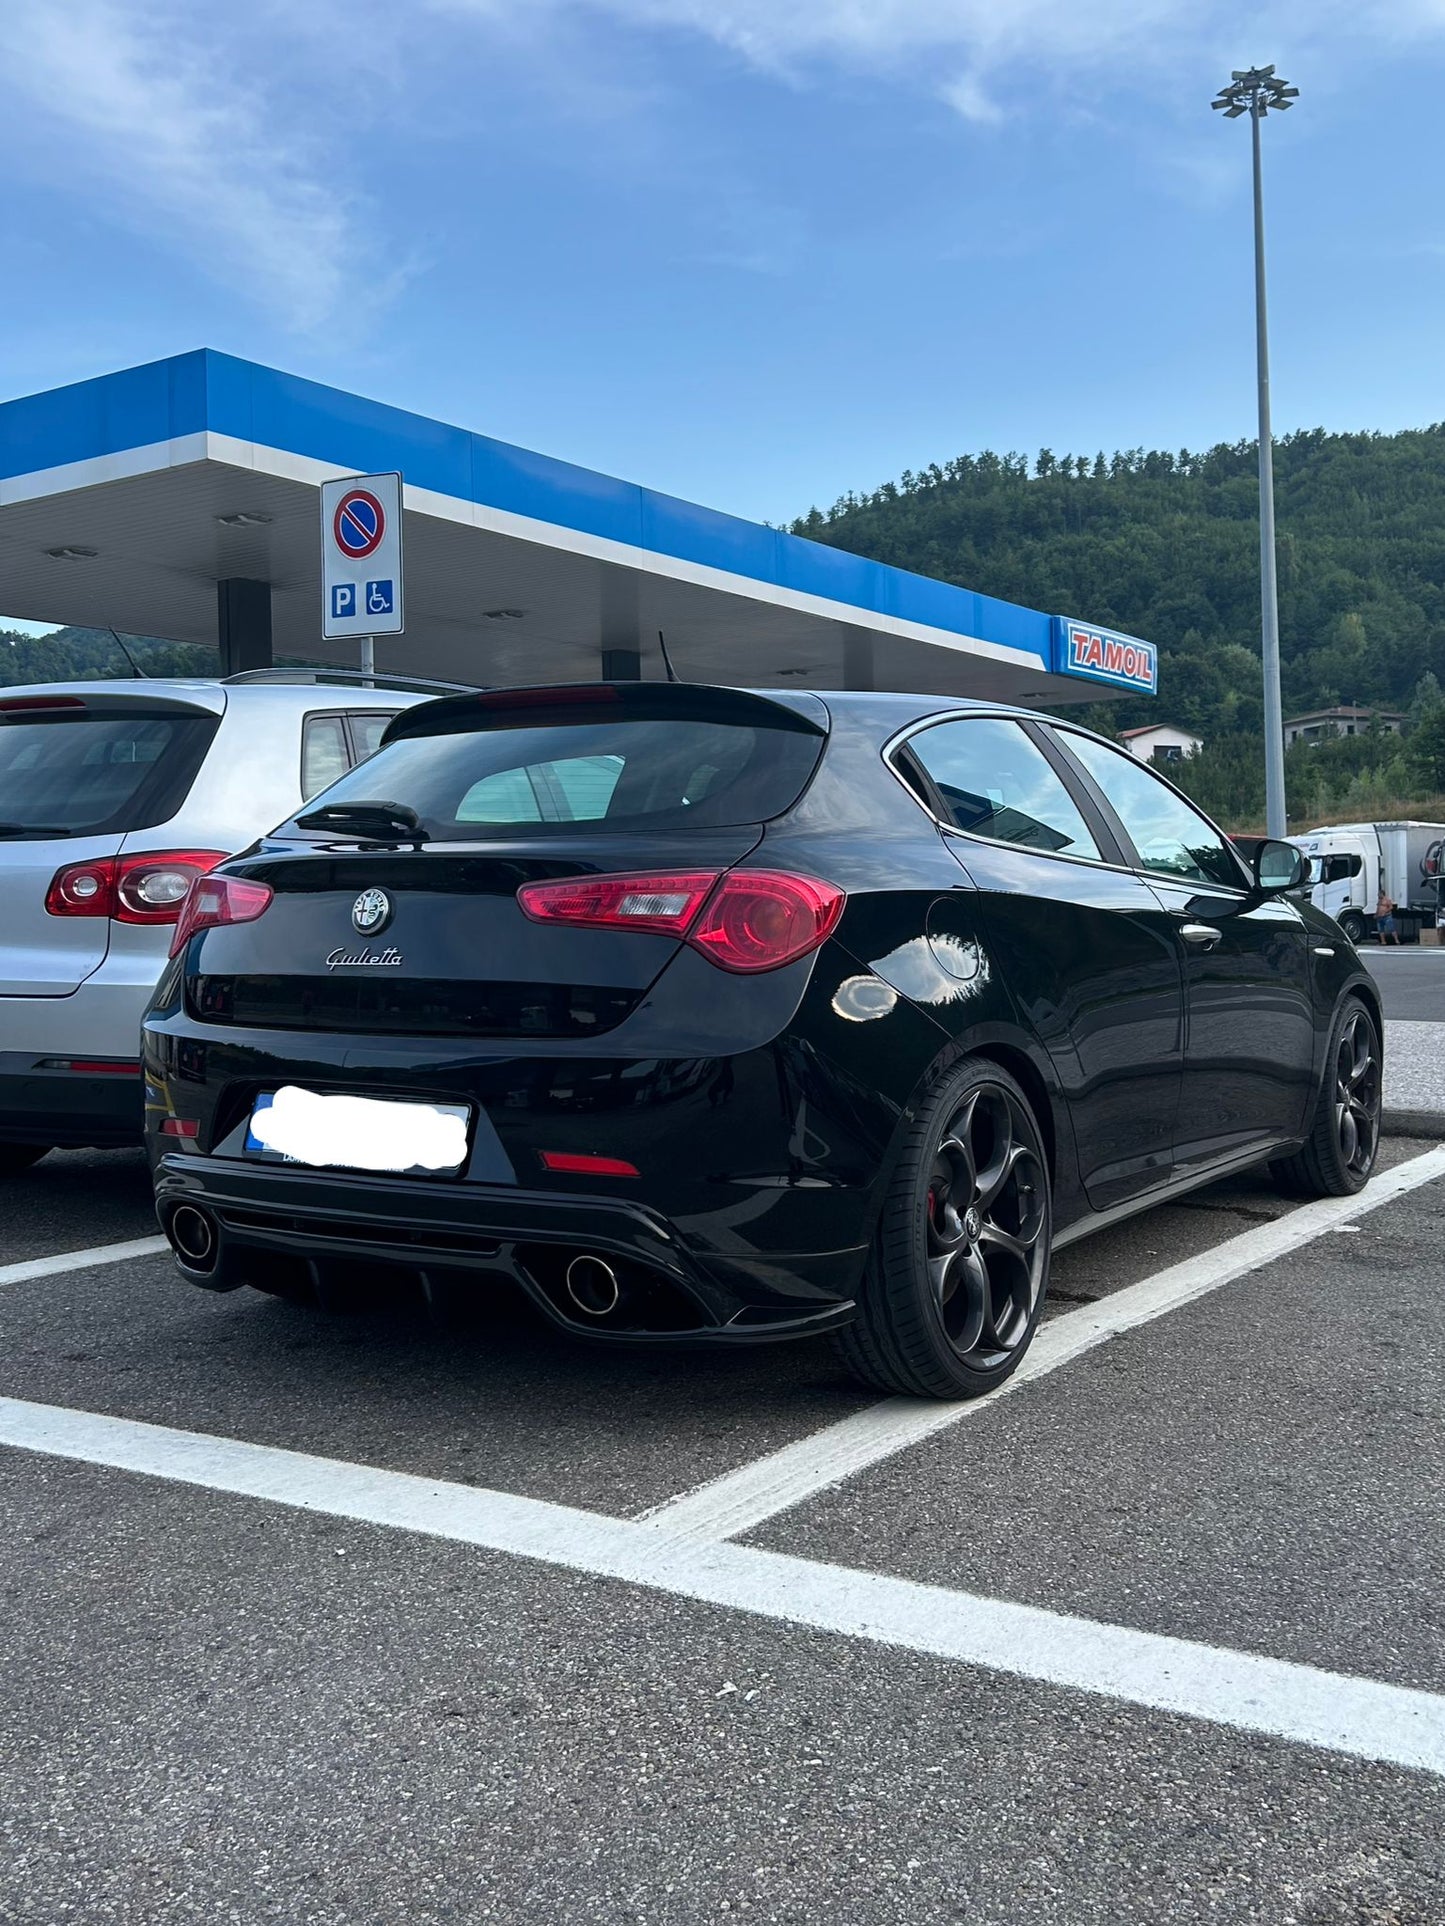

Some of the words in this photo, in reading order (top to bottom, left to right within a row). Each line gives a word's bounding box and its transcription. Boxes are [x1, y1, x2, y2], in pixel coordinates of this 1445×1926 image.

[336, 587, 351, 614] P
[1072, 632, 1152, 681] TAMOIL
[326, 947, 403, 971] Giulietta
